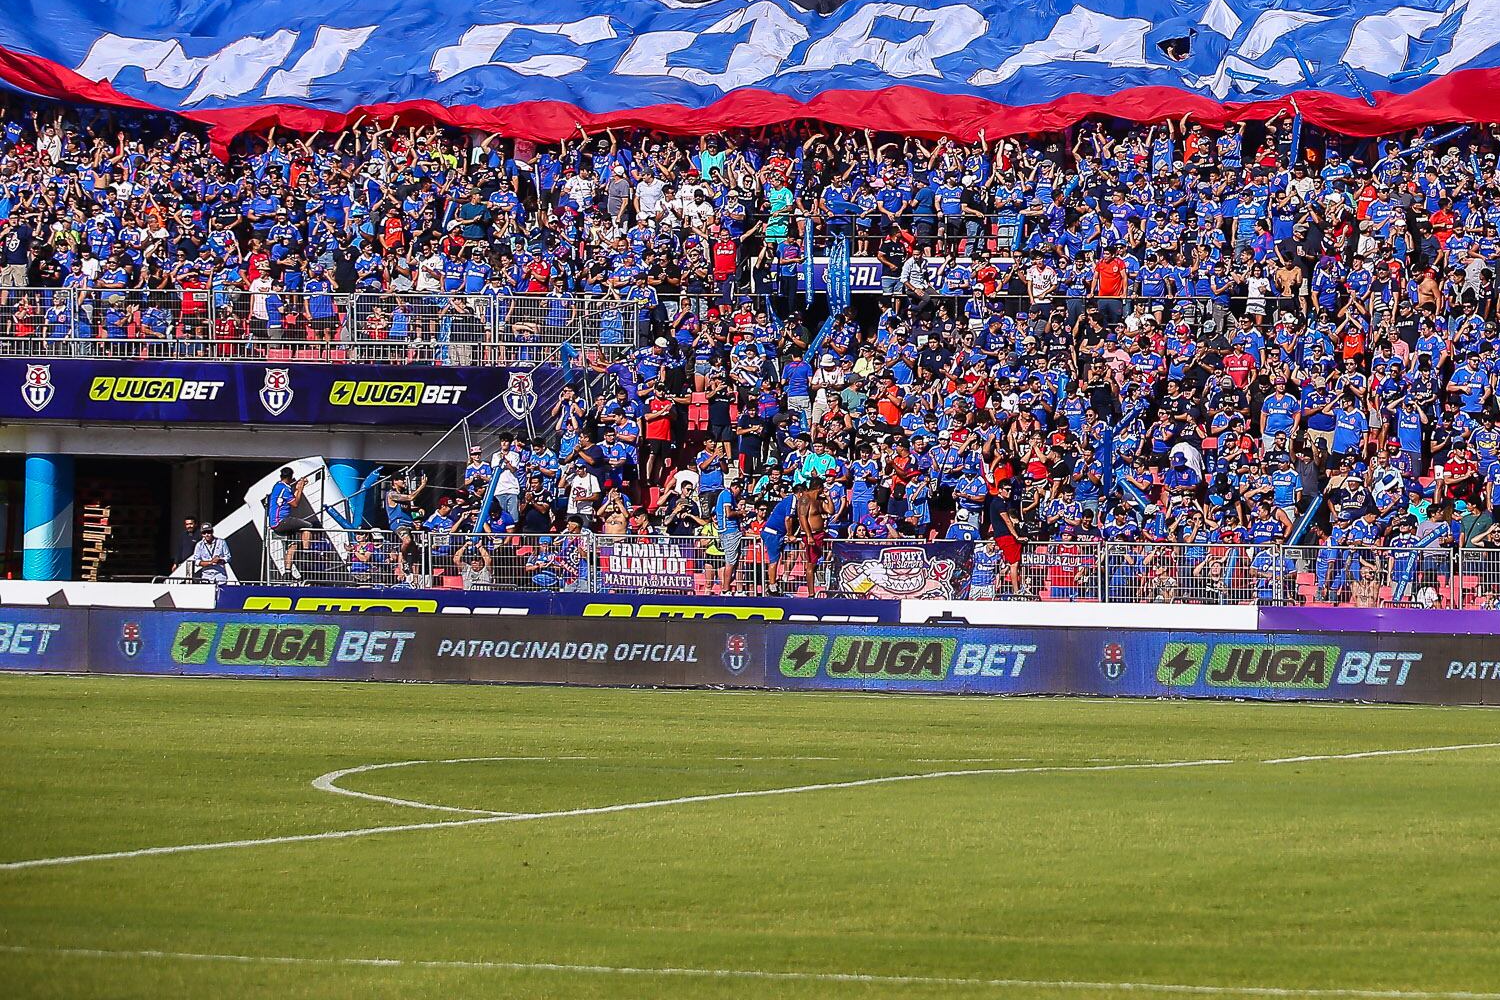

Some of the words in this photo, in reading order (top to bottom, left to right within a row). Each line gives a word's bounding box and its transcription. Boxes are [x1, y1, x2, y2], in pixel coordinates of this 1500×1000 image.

[114, 379, 224, 401] JUGABET
[355, 383, 467, 405] JUGABET
[613, 543, 682, 557] FAMILIA
[609, 556, 687, 574] BLANLOT
[605, 574, 648, 587] MARTINA
[660, 576, 693, 587] MAITE
[220, 627, 416, 663] JUGABET
[438, 639, 608, 661] PATROCINADOR
[614, 643, 698, 663] OFICIAL
[829, 639, 1036, 677] JUGABET
[1211, 647, 1422, 685] JUGABET
